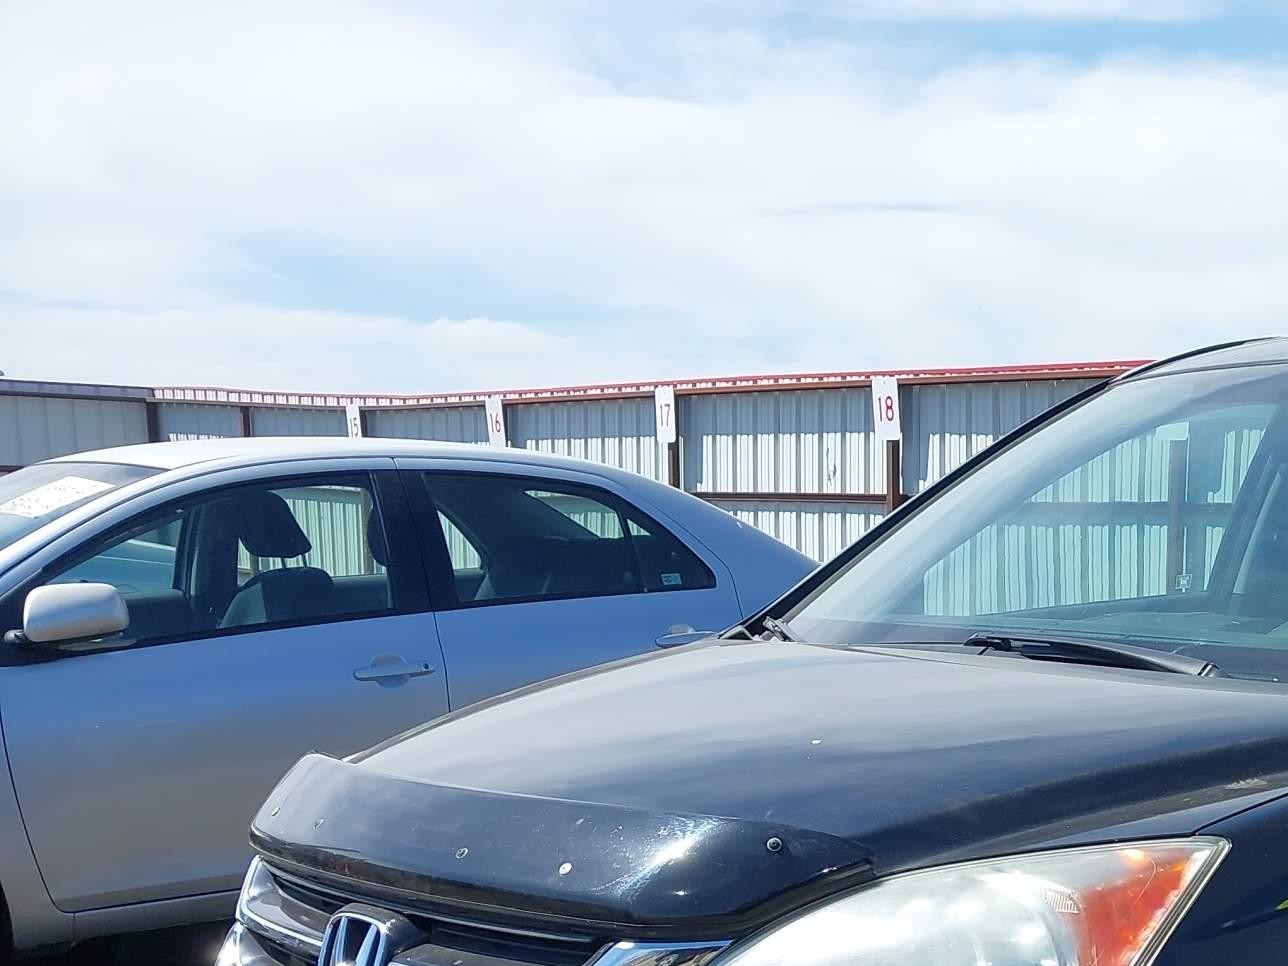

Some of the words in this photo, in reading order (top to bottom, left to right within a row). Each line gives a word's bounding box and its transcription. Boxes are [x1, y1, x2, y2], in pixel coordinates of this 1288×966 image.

[659, 403, 671, 427] 17
[877, 395, 895, 422] 18
[489, 412, 502, 433] 16
